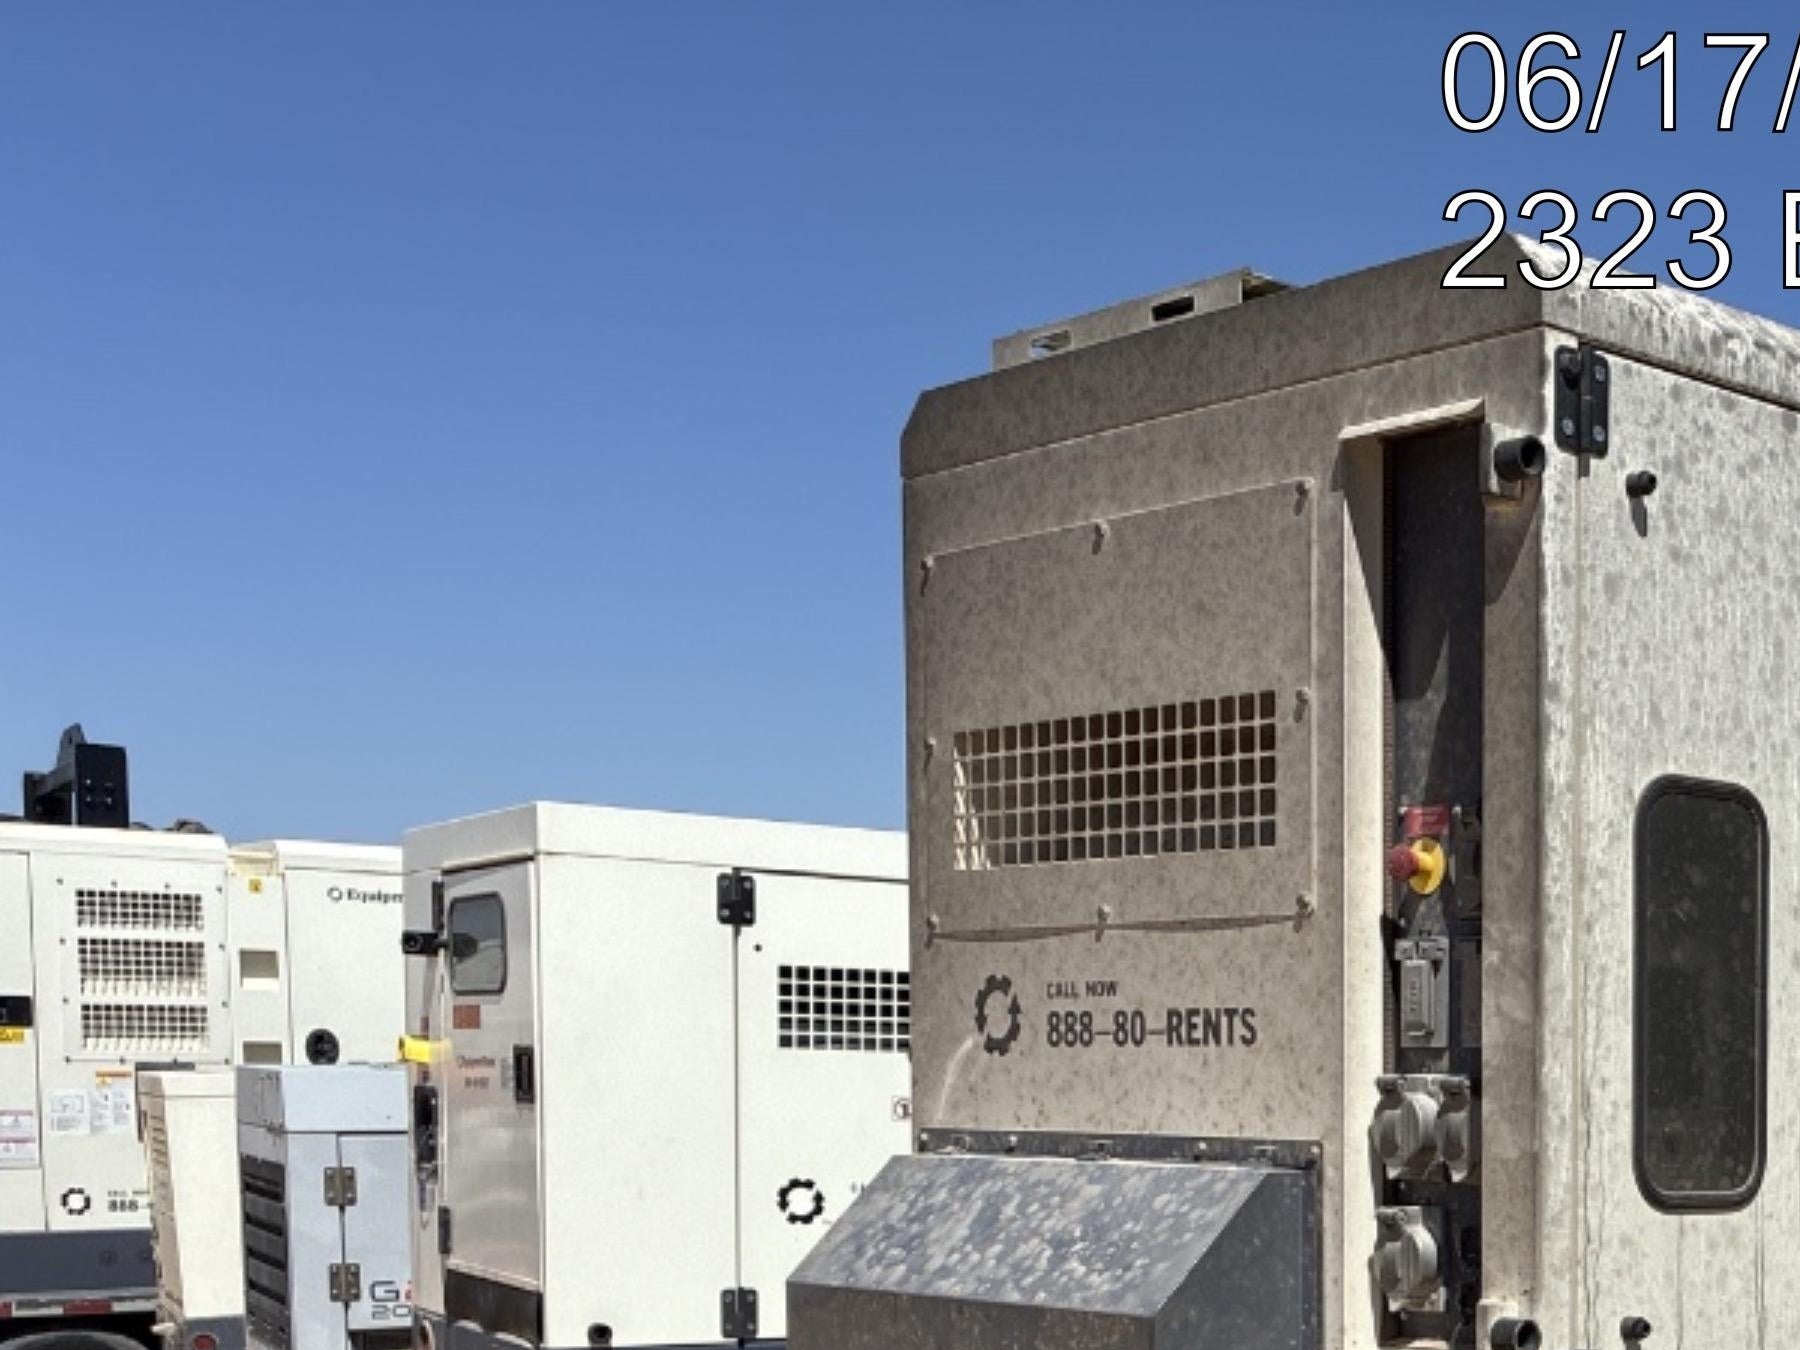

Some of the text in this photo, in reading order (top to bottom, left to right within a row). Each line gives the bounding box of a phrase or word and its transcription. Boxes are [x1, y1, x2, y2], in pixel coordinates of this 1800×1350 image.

[1046, 980, 1119, 999] CALL NOW
[1046, 1007, 1257, 1048] 888-80-RENTS
